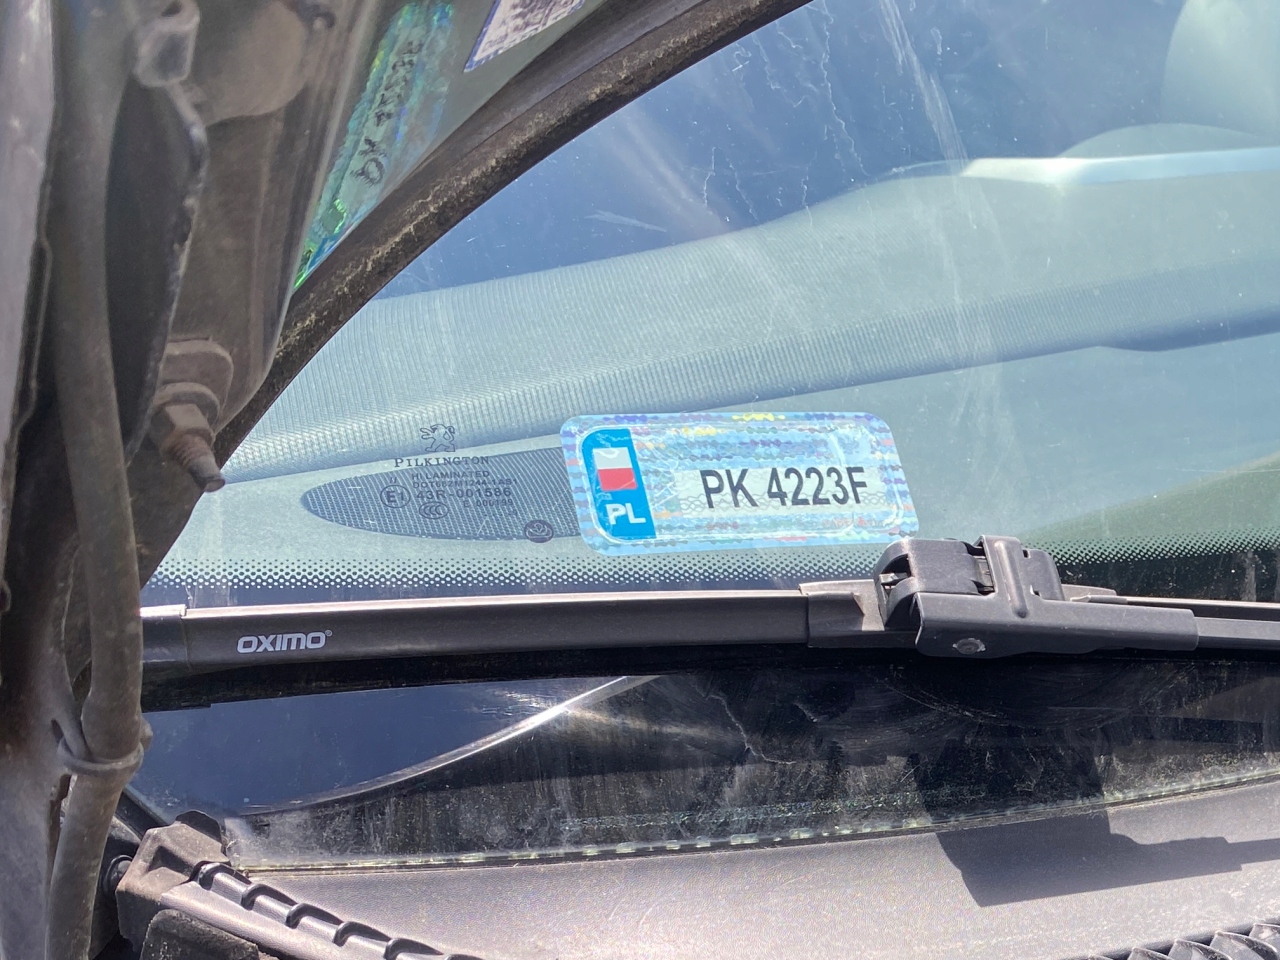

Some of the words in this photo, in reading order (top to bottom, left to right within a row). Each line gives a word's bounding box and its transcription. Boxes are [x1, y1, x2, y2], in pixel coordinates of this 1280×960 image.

[394, 456, 490, 468] PILKINGTON
[425, 470, 490, 481] LAMINATED
[699, 468, 759, 509] PK
[766, 466, 868, 507] 4223F
[605, 502, 647, 526] PL
